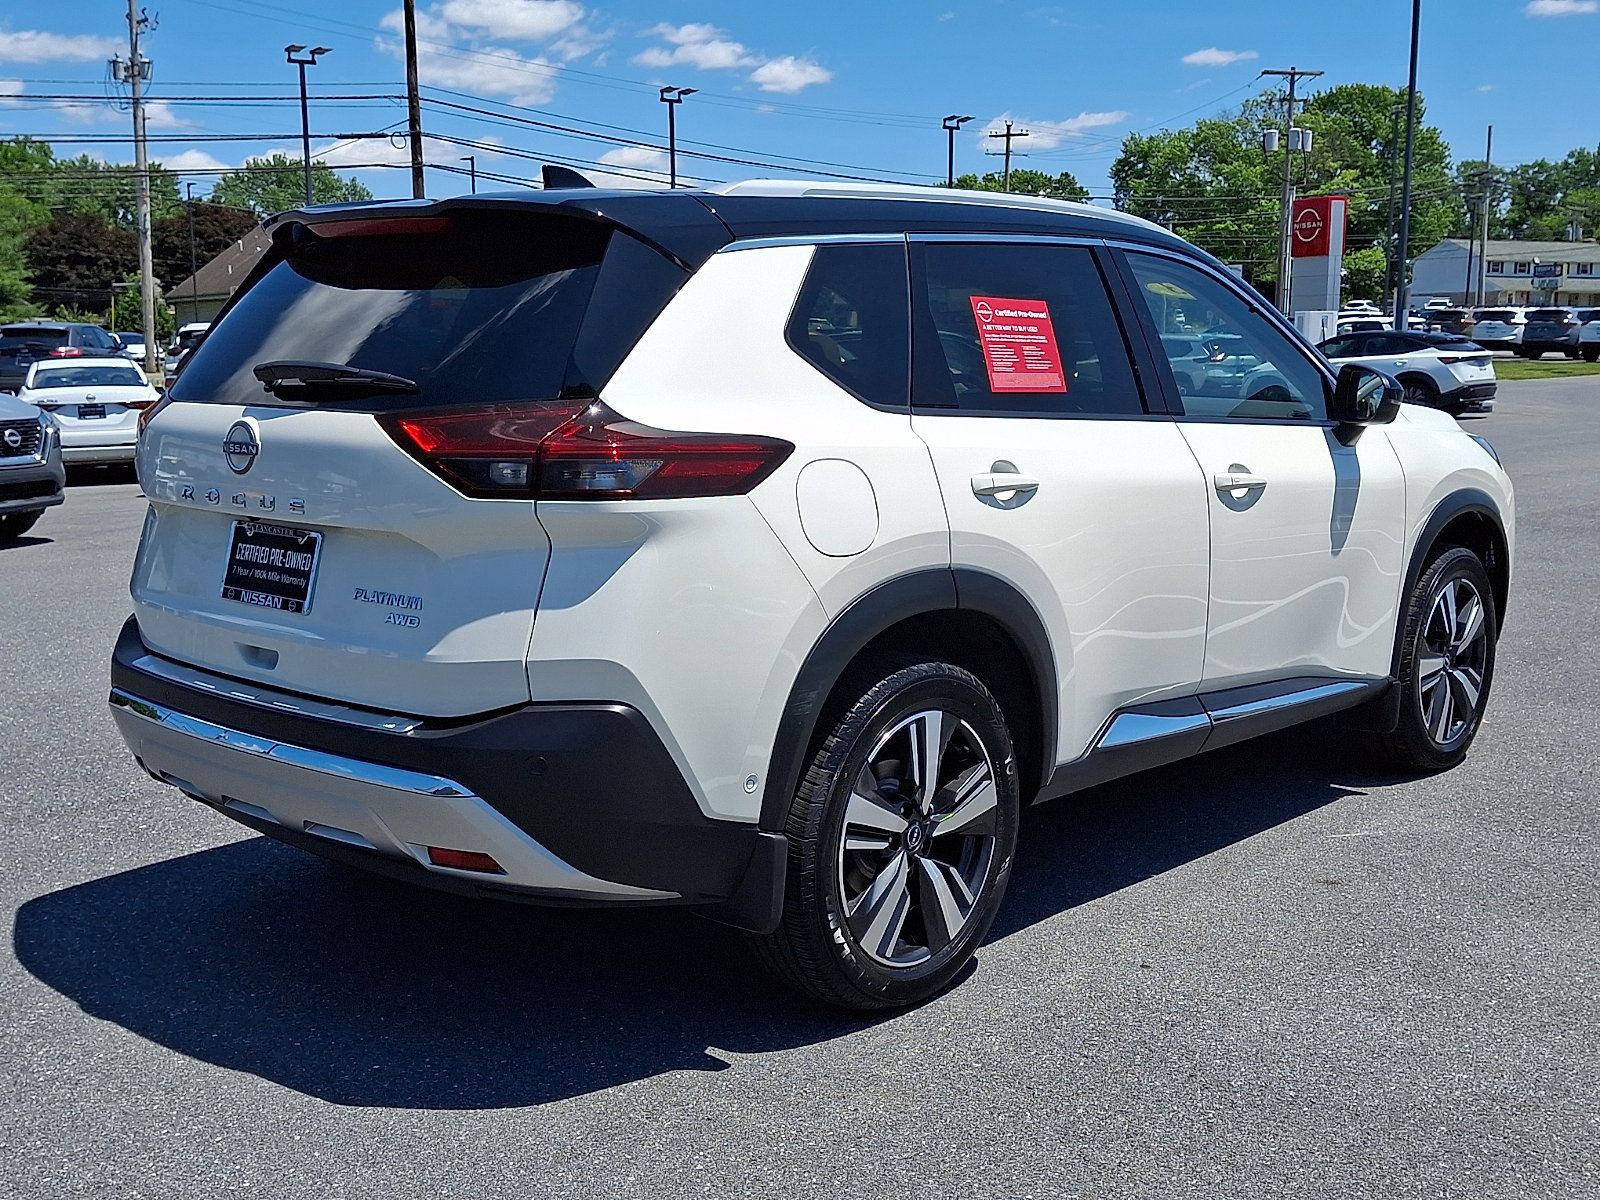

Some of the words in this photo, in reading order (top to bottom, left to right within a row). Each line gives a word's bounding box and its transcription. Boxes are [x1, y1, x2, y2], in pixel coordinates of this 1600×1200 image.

[1294, 221, 1322, 230] NISSAN
[995, 308, 1018, 317] Certified
[1018, 310, 1047, 319] Pre-Owned
[223, 442, 257, 454] SSAN
[181, 485, 305, 515] ROGUE
[255, 524, 294, 537] LANCASTER
[236, 543, 270, 564] CERTIFIED
[269, 548, 312, 571] PRE-OWNED
[232, 565, 237, 574] 7
[237, 566, 249, 576] Year
[254, 569, 268, 579] 100k
[267, 571, 280, 582] Mile
[281, 573, 307, 589] Warranty
[240, 591, 282, 609] NISSAN
[353, 587, 423, 611] PLATINUM
[384, 612, 421, 628] AWD
